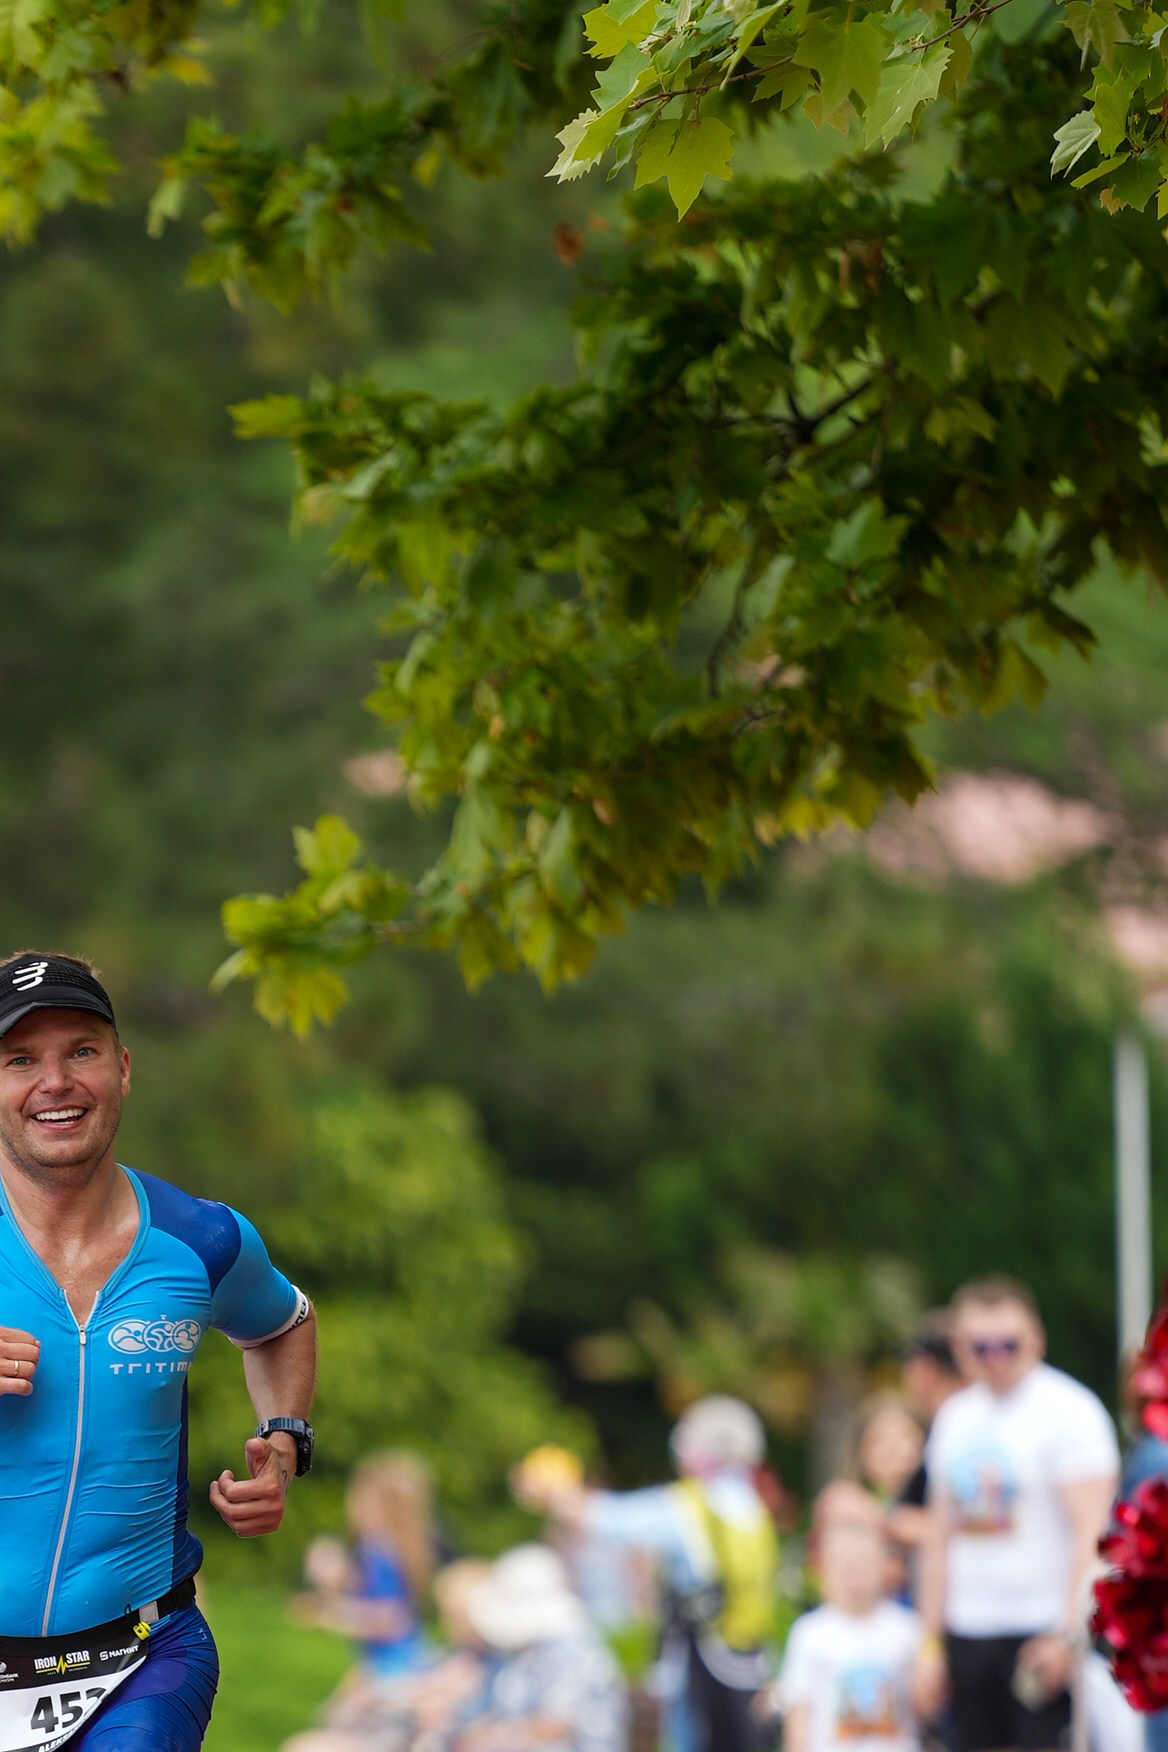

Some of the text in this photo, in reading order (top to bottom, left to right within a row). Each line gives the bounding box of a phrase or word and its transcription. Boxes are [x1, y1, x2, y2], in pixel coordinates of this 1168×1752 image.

[110, 1361, 192, 1375] TRITIM
[109, 1645, 139, 1658] МАГНИТ
[34, 1656, 57, 1670] IRON
[65, 1650, 90, 1664] STAR
